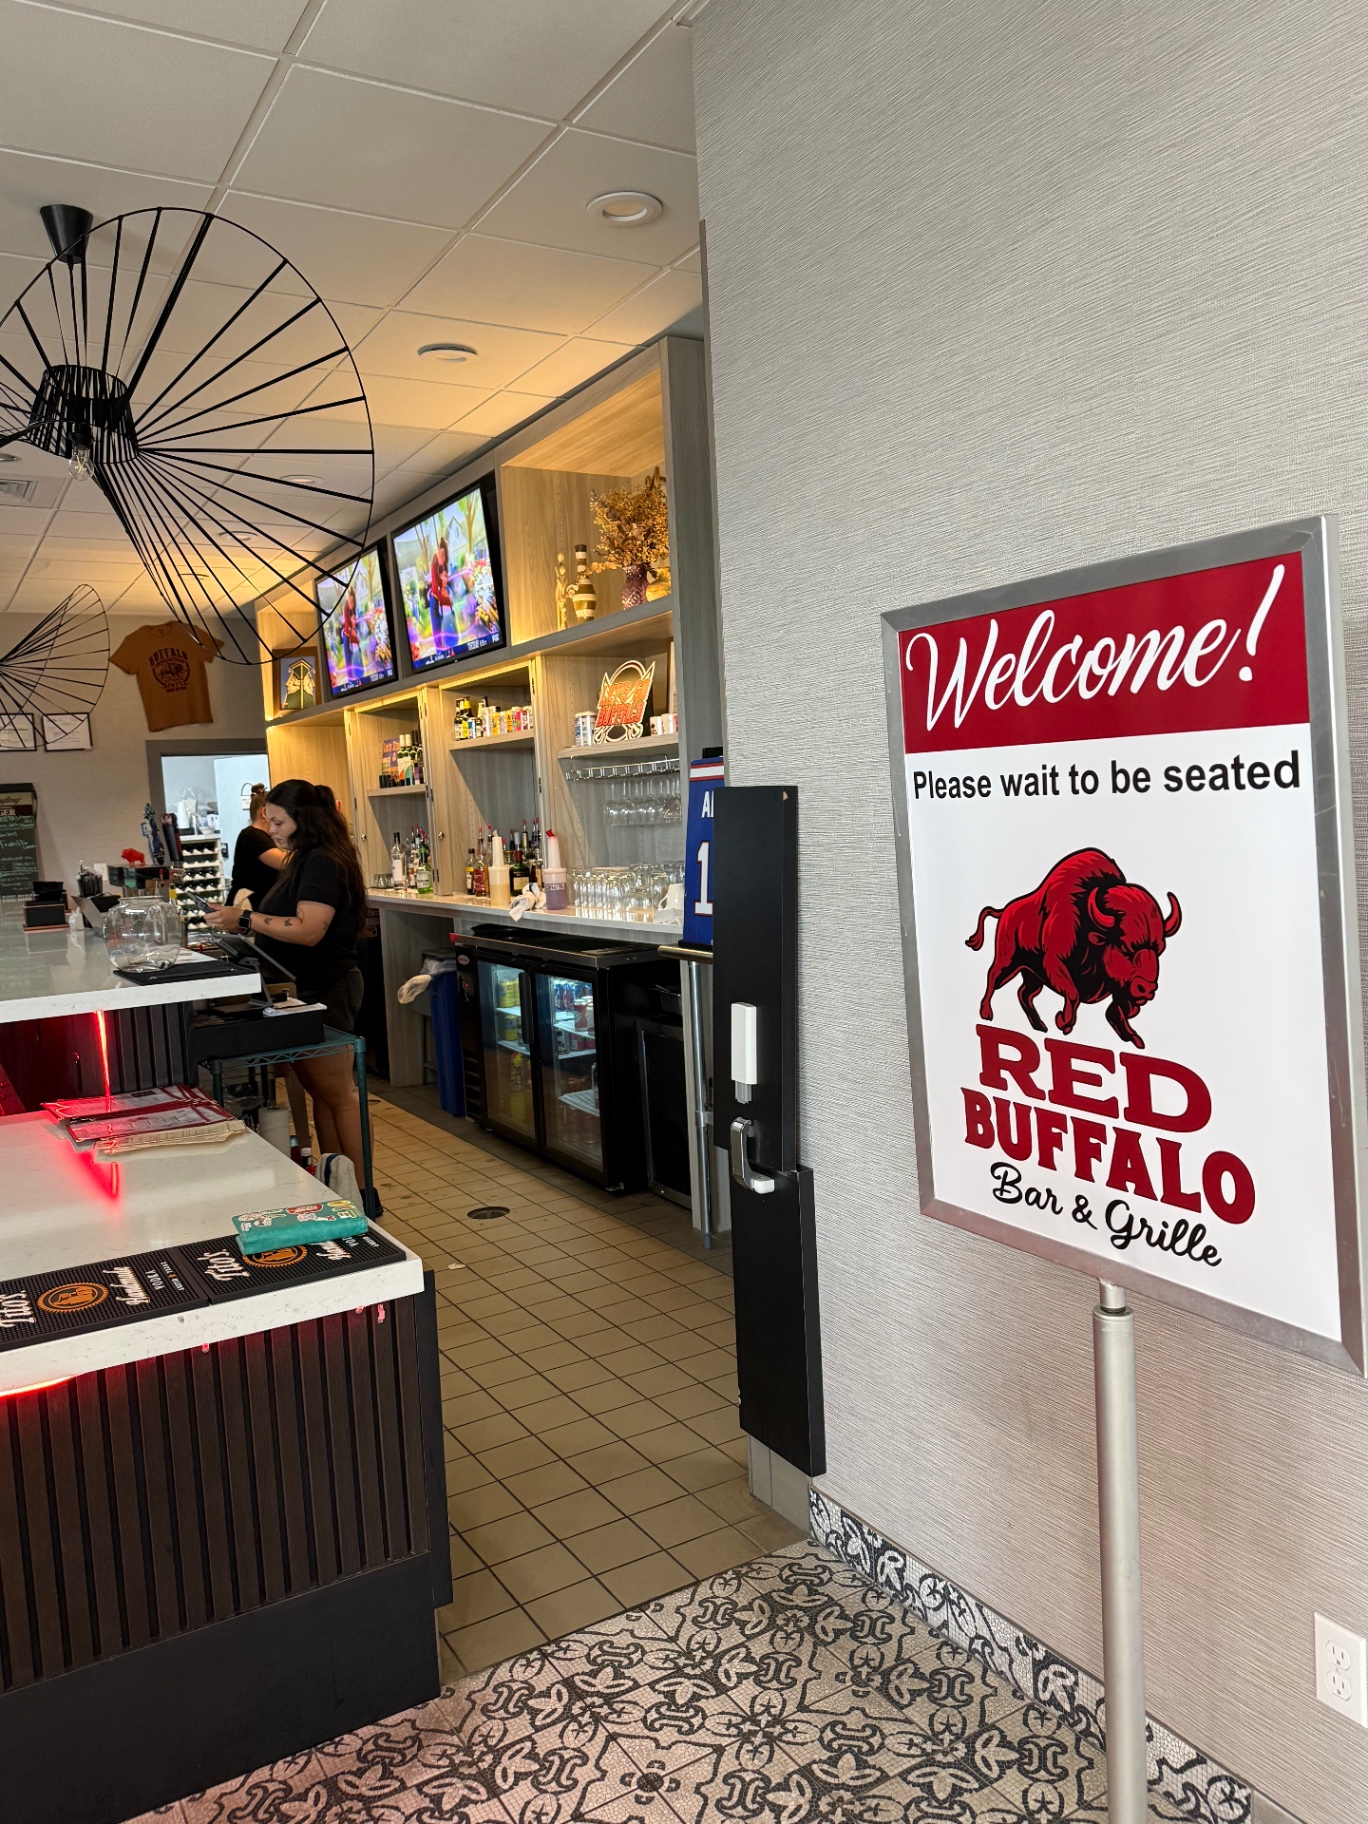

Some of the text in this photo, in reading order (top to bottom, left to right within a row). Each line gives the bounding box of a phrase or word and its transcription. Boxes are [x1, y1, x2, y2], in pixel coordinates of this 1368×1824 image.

[148, 647, 189, 667] BUFFALO
[905, 563, 1285, 732] Welcome!
[596, 700, 646, 727] BUFFALO
[913, 749, 1301, 800] Please wait to be seated
[694, 840, 713, 916] 1
[975, 1023, 1213, 1134] RED
[960, 1086, 1256, 1225] BUFFALO
[990, 1161, 1222, 1267] Bar & Grille
[102, 1266, 150, 1306] Handmade
[197, 1248, 251, 1281] Tito's
